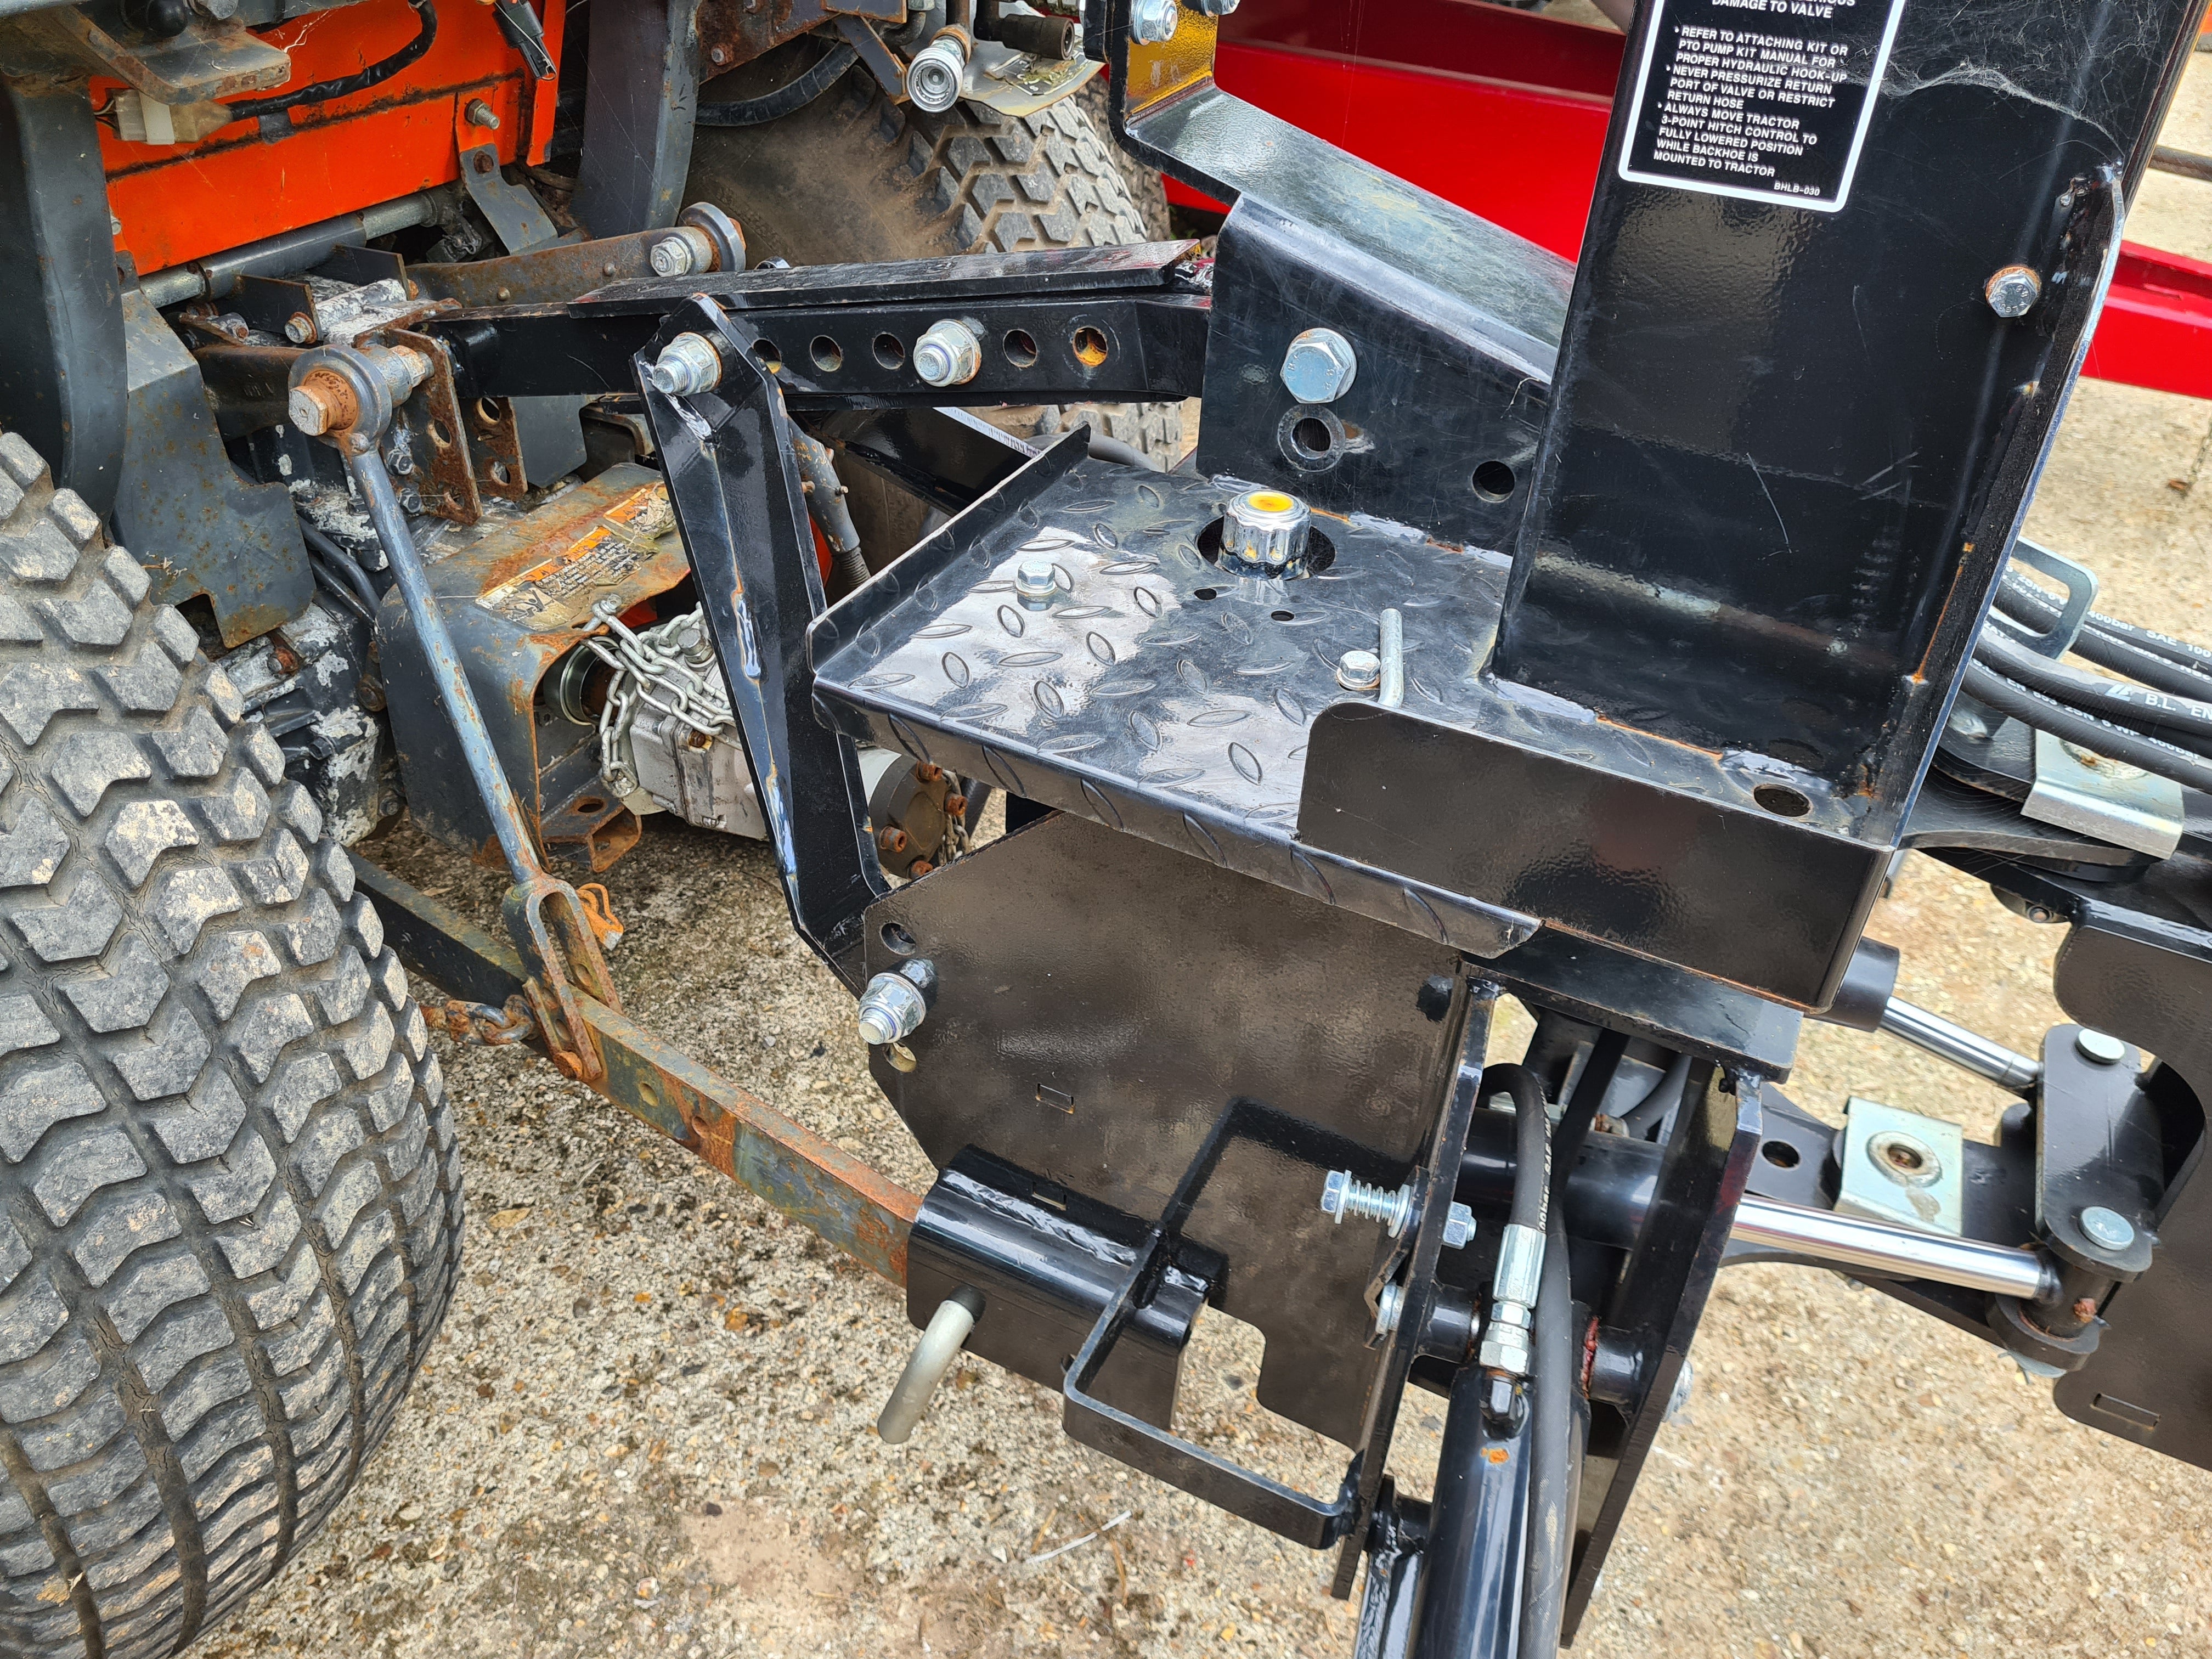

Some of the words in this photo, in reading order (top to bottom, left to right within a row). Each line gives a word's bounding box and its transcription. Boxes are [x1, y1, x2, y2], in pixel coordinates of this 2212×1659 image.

[1770, 1, 1787, 13] TO
[1791, 2, 1833, 19] VALVE
[1678, 38, 1700, 51] PTO
[1702, 42, 1734, 55] PUMP
[1736, 46, 1757, 58] KIT
[1760, 48, 1808, 65] MANUAL
[1812, 55, 1836, 68] FOR
[1681, 25, 1717, 40] REFER
[1719, 30, 1734, 42] TO
[1736, 31, 1803, 50] ATTACHING
[1807, 40, 1827, 53] KIT
[1830, 43, 1848, 56] OR
[1673, 64, 1708, 78] NEVER
[1711, 69, 1782, 88] PRESSURIZE
[1785, 78, 1832, 94] RETURN
[1676, 50, 1719, 66] PROPER
[1722, 58, 1788, 75] HYDRAULIC
[1791, 66, 1847, 82] HOOK-UP
[1667, 88, 1711, 105] RETURN
[1713, 95, 1745, 109] HOSE
[1670, 76, 1701, 91] PORT
[1702, 82, 1719, 93] OF
[1721, 83, 1755, 98] VALVE
[1758, 88, 1775, 100] OR
[1778, 91, 1836, 108] RESTRICT
[1661, 114, 1706, 129] 3-POINT
[1707, 120, 1742, 135] HITCH
[1745, 126, 1799, 143] CONTROL
[1803, 133, 1818, 145] TO
[1664, 101, 1708, 117] ALWAYS
[1711, 109, 1744, 122] MOVE
[1746, 113, 1800, 129] TRACTOR
[1657, 138, 1690, 153] WHILE
[1692, 144, 1746, 160] BACKHOE
[1747, 151, 1758, 162] IS
[1659, 125, 1692, 140] FULLY
[1694, 131, 1748, 148] LOWERED
[1751, 137, 1803, 156] POSITION
[1654, 149, 1706, 167] MOUNTED
[1708, 158, 1722, 170] TO
[1724, 160, 1775, 177] TRACTOR
[1774, 179, 1820, 196] BHLB-030
[2087, 611, 2136, 631] 400bar
[2146, 630, 2177, 646] SAE
[2145, 693, 2176, 711] B.L.
